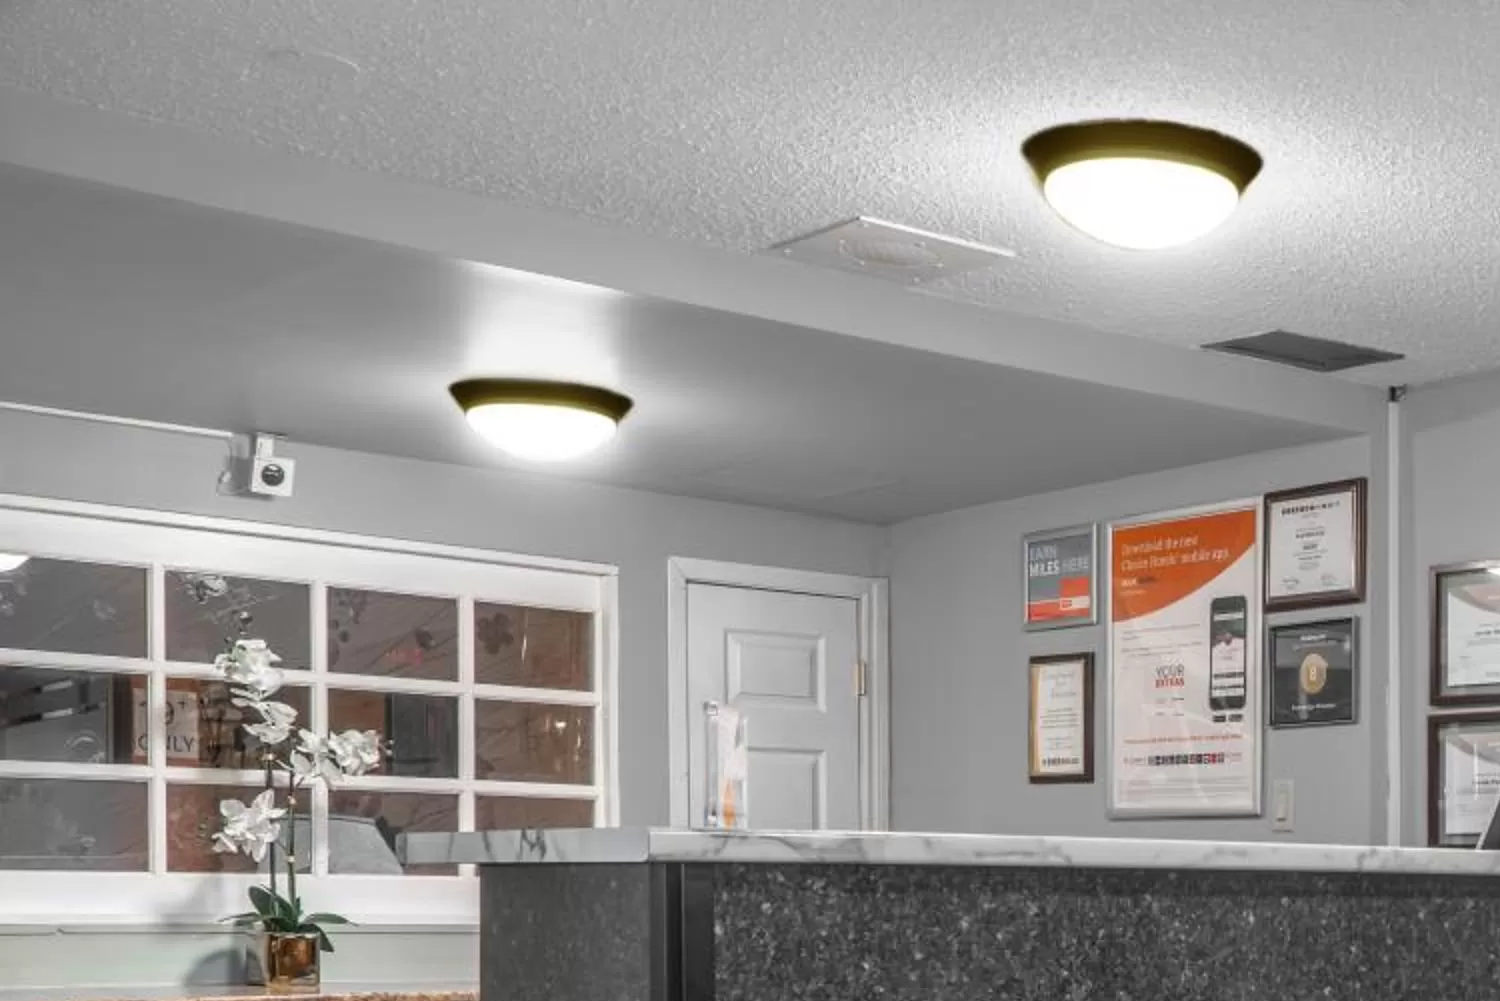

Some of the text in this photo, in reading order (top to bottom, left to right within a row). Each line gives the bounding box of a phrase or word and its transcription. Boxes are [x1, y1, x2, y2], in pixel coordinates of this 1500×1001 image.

[1029, 555, 1089, 577] MILES HERE
[1155, 663, 1185, 678] YOUR
